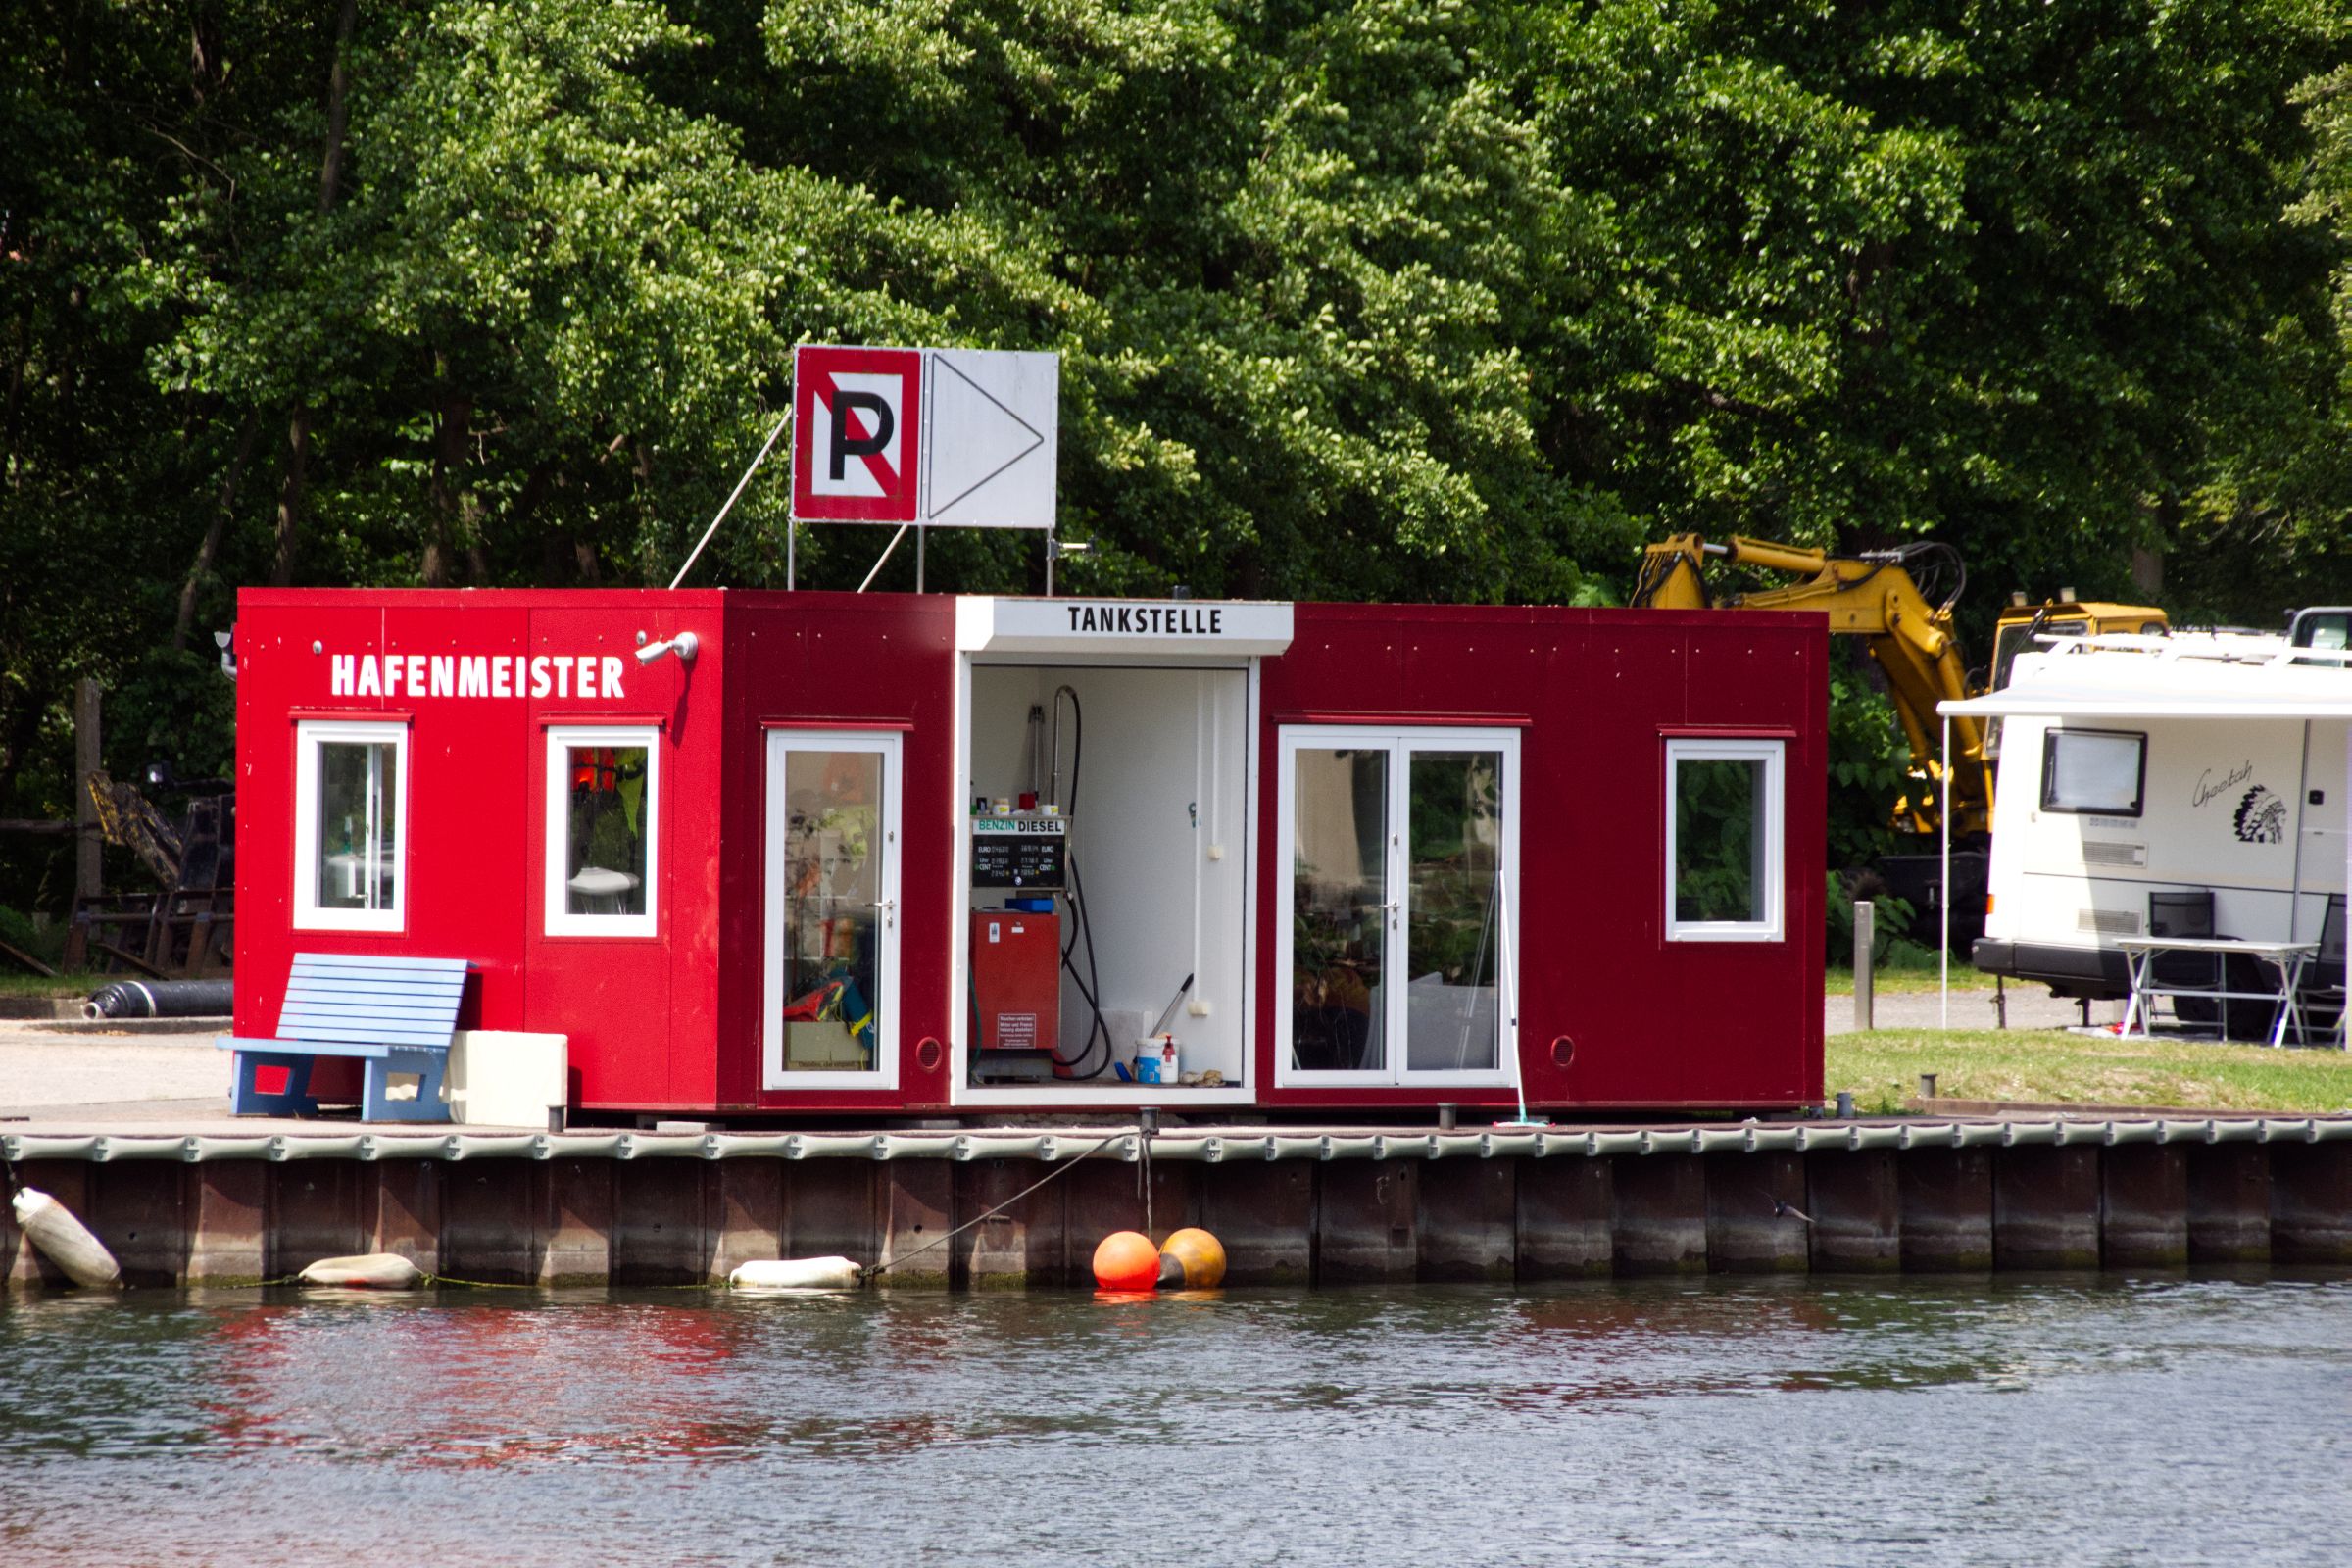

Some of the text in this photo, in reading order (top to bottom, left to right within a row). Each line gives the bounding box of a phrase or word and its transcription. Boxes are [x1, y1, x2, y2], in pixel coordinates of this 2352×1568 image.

[829, 390, 894, 481] P
[1067, 606, 1222, 634] TANKSTELLE
[331, 654, 625, 698] HAFENMEISTER
[2192, 760, 2253, 808] Cheetah
[979, 819, 1062, 832] BENZIN DIESEL
